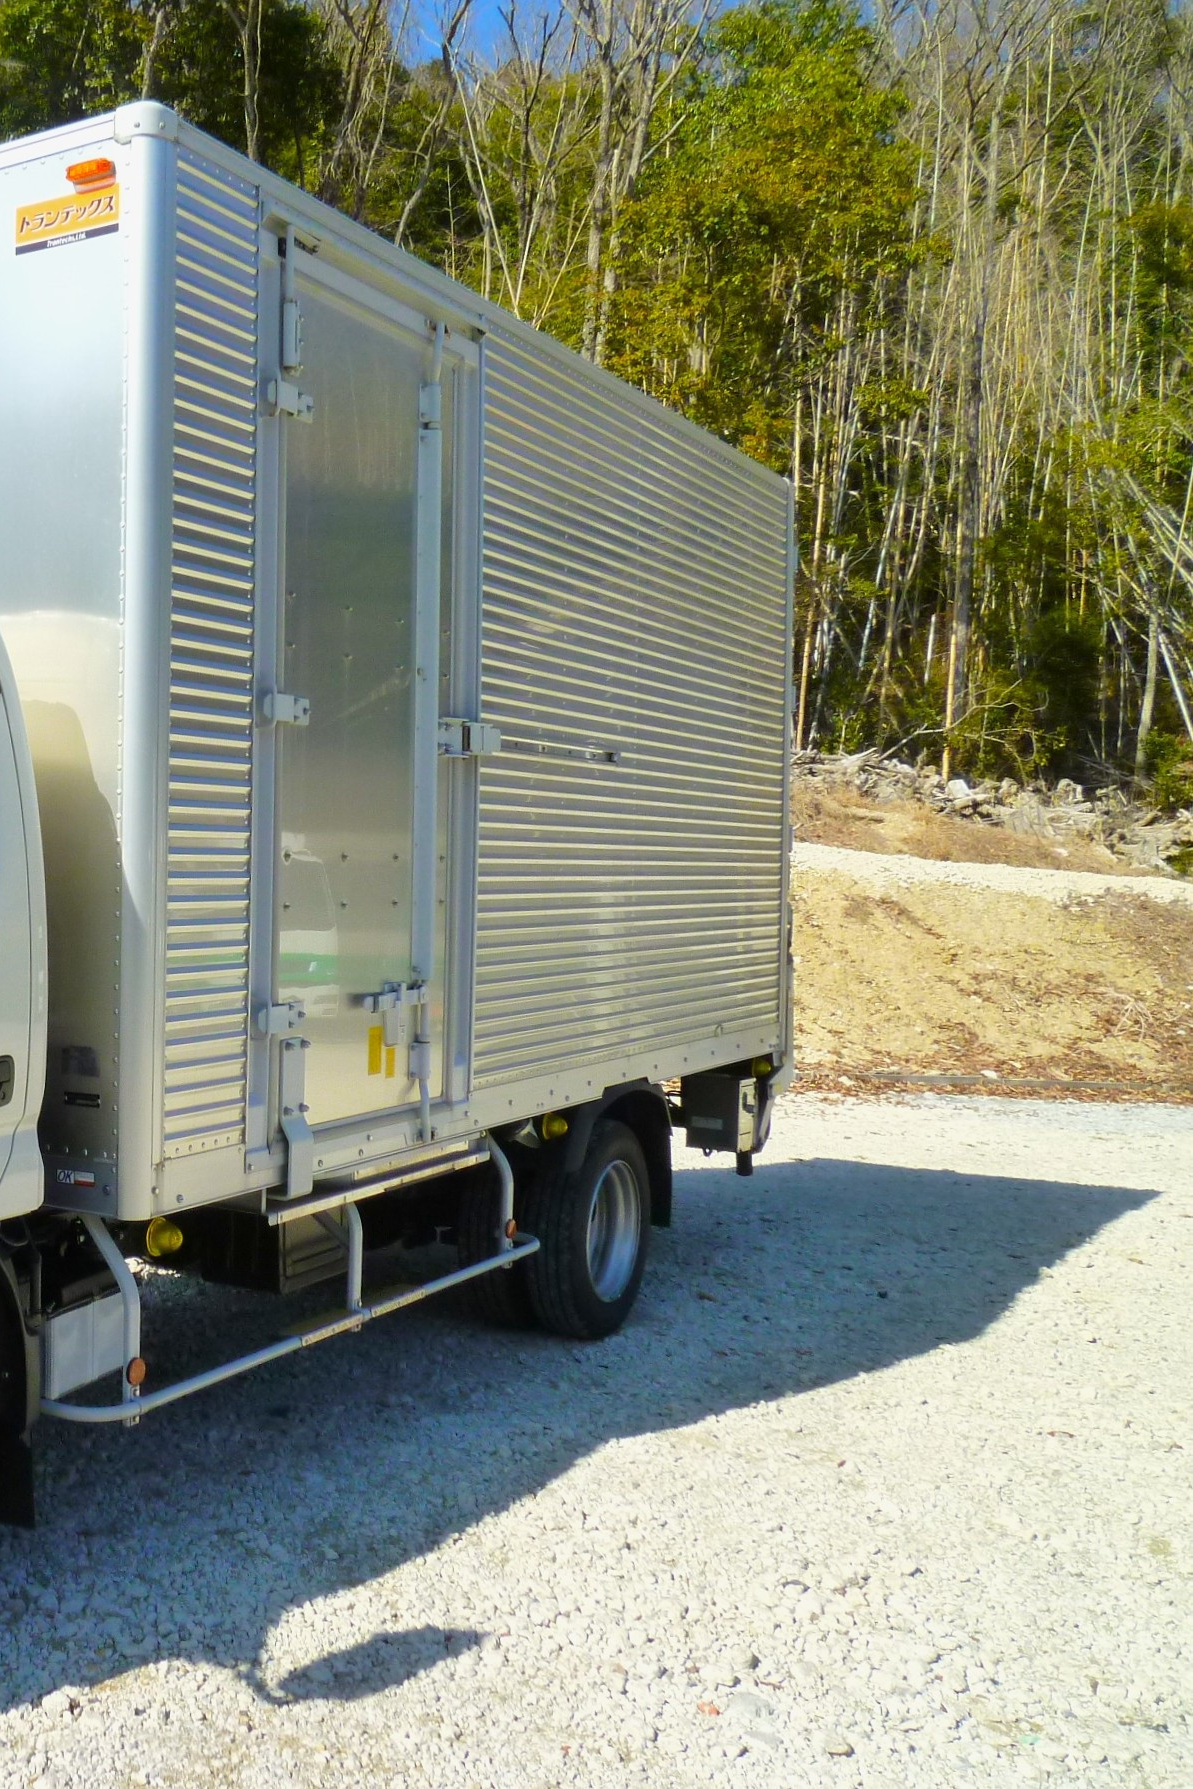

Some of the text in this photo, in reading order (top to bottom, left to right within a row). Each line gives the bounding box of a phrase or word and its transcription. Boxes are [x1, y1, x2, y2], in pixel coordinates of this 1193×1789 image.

[20, 195, 114, 234] トランテックス
[58, 1170, 73, 1183] OK
